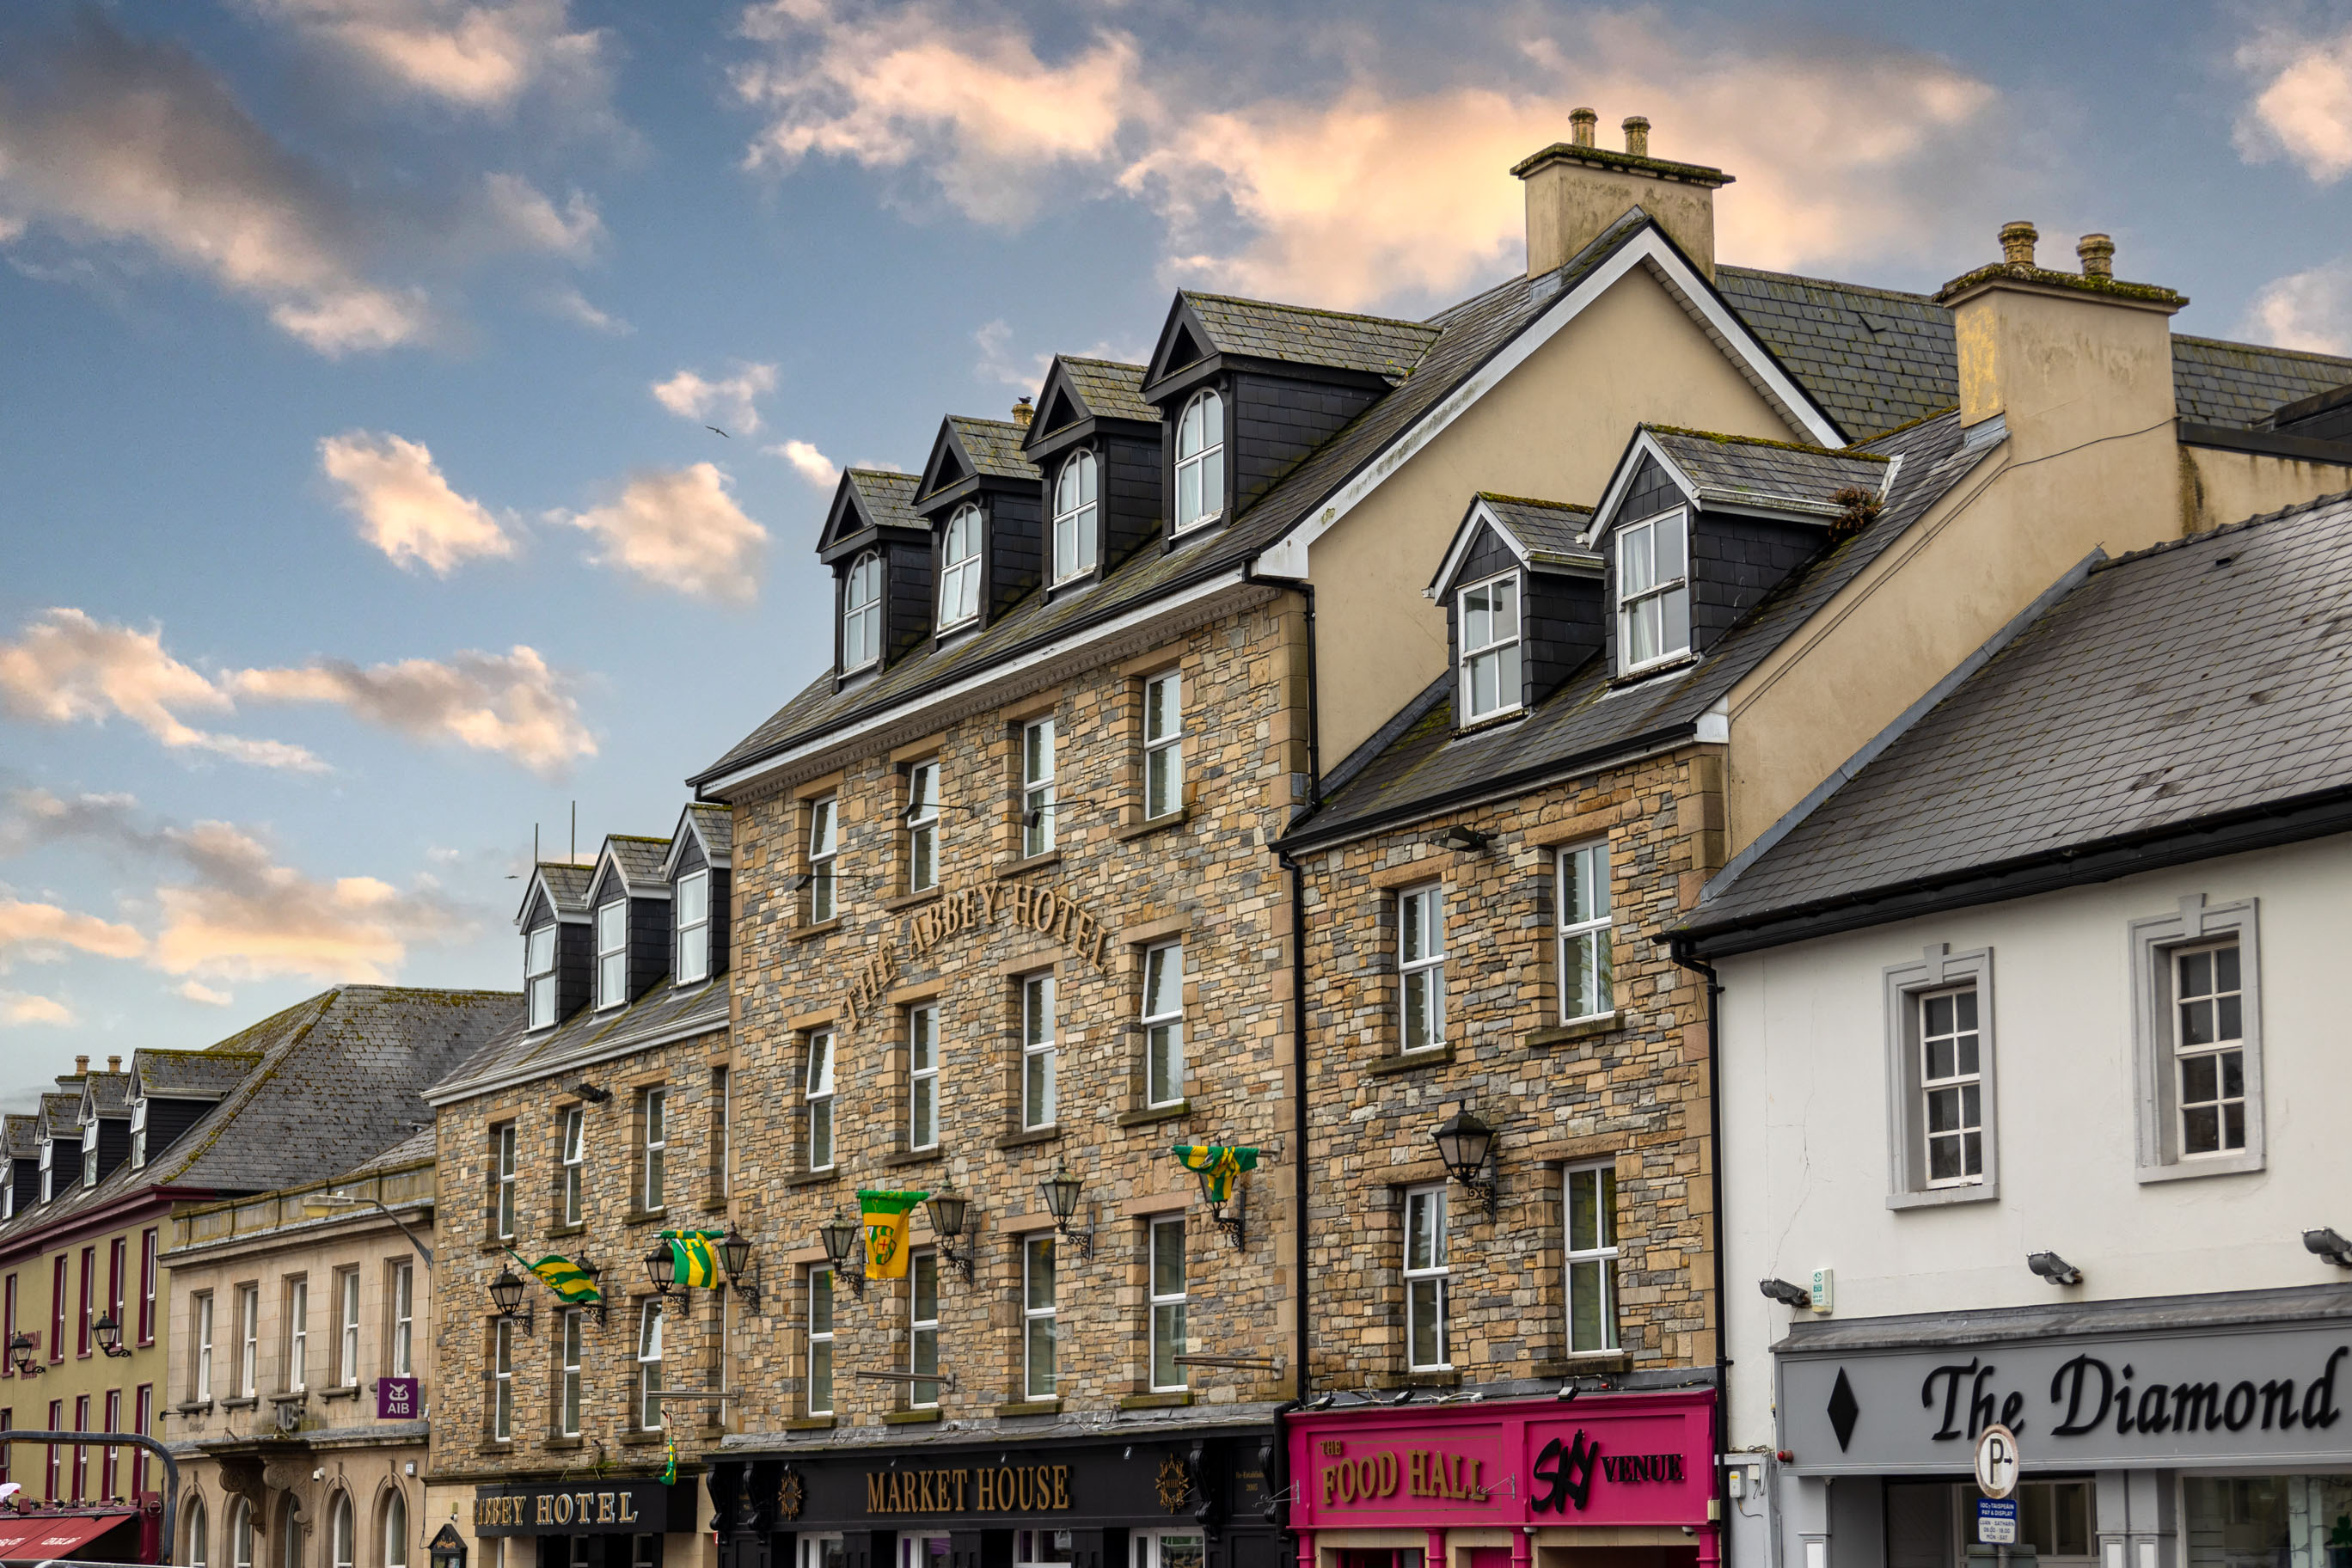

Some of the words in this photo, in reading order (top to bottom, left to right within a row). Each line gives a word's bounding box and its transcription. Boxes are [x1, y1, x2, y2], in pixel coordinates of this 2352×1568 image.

[841, 941, 897, 1032] THE
[908, 882, 1000, 962] ABBEY
[1013, 883, 1108, 975] HOTEL
[387, 1402, 410, 1414] AIB
[1921, 1356, 2024, 1441] The
[2050, 1345, 2349, 1436] Diamond
[1320, 1440, 1342, 1455] THE
[1531, 1429, 1599, 1514] SKY
[1601, 1454, 1683, 1483] VENUE
[1990, 1438, 2004, 1485] P
[867, 1469, 968, 1513] MARKET
[977, 1465, 1069, 1511] HOUSE
[1321, 1450, 1398, 1504] FOOD
[1406, 1449, 1487, 1501] HALL
[478, 1496, 526, 1526] ABBEY
[536, 1492, 638, 1526] HOTEL
